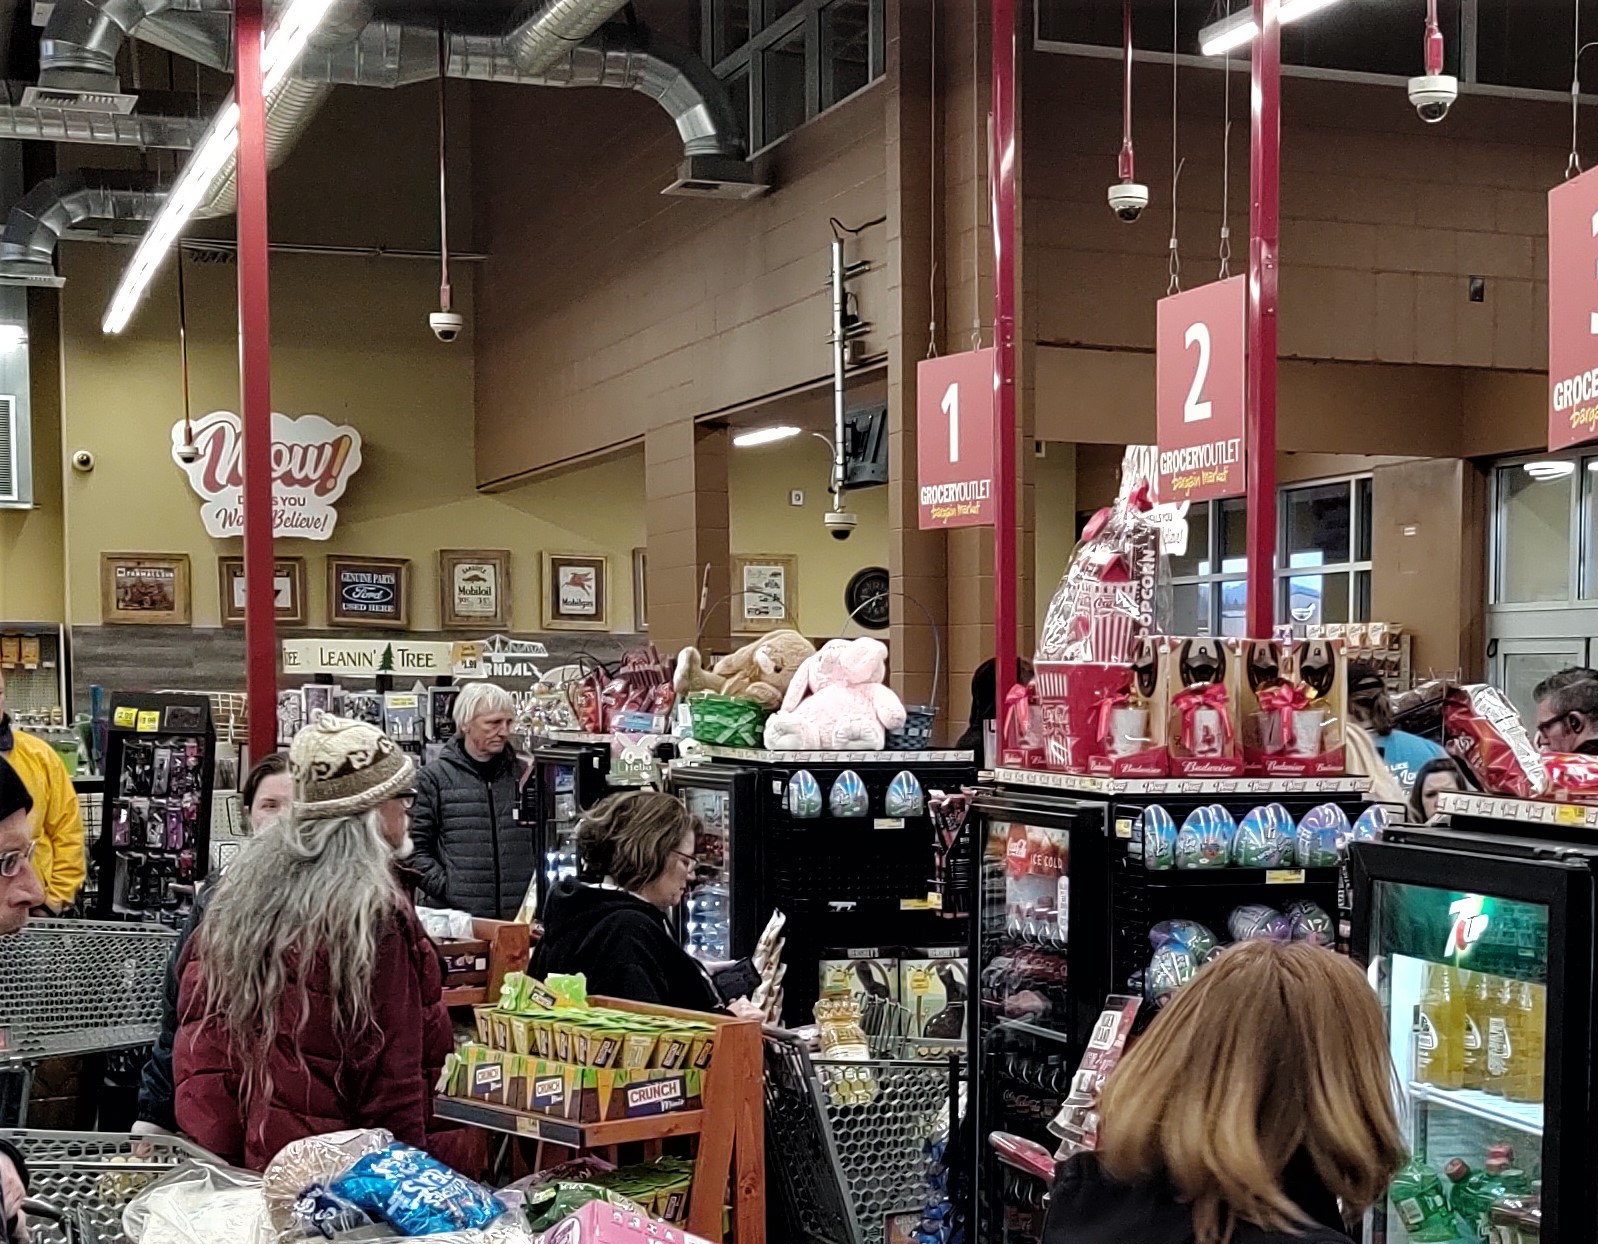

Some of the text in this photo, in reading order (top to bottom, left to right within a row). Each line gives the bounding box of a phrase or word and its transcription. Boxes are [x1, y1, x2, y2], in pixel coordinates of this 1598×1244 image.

[1184, 322, 1212, 423] 2
[941, 383, 959, 463] 1
[1171, 468, 1229, 496] bargain market
[281, 497, 306, 506] YOU
[341, 572, 395, 584] GENUINE PARTS
[351, 585, 385, 602] Ford
[458, 586, 492, 597] Mobiloil
[342, 602, 394, 613] USED HERE
[319, 647, 377, 667] LEANIN'
[397, 648, 436, 668] TREE
[1182, 761, 1236, 774] Budweiser
[1044, 856, 1063, 869] COLD
[478, 1067, 500, 1083] CRUNCH
[537, 1080, 561, 1095] CRUNCH
[630, 1083, 677, 1104] CRUNCH
